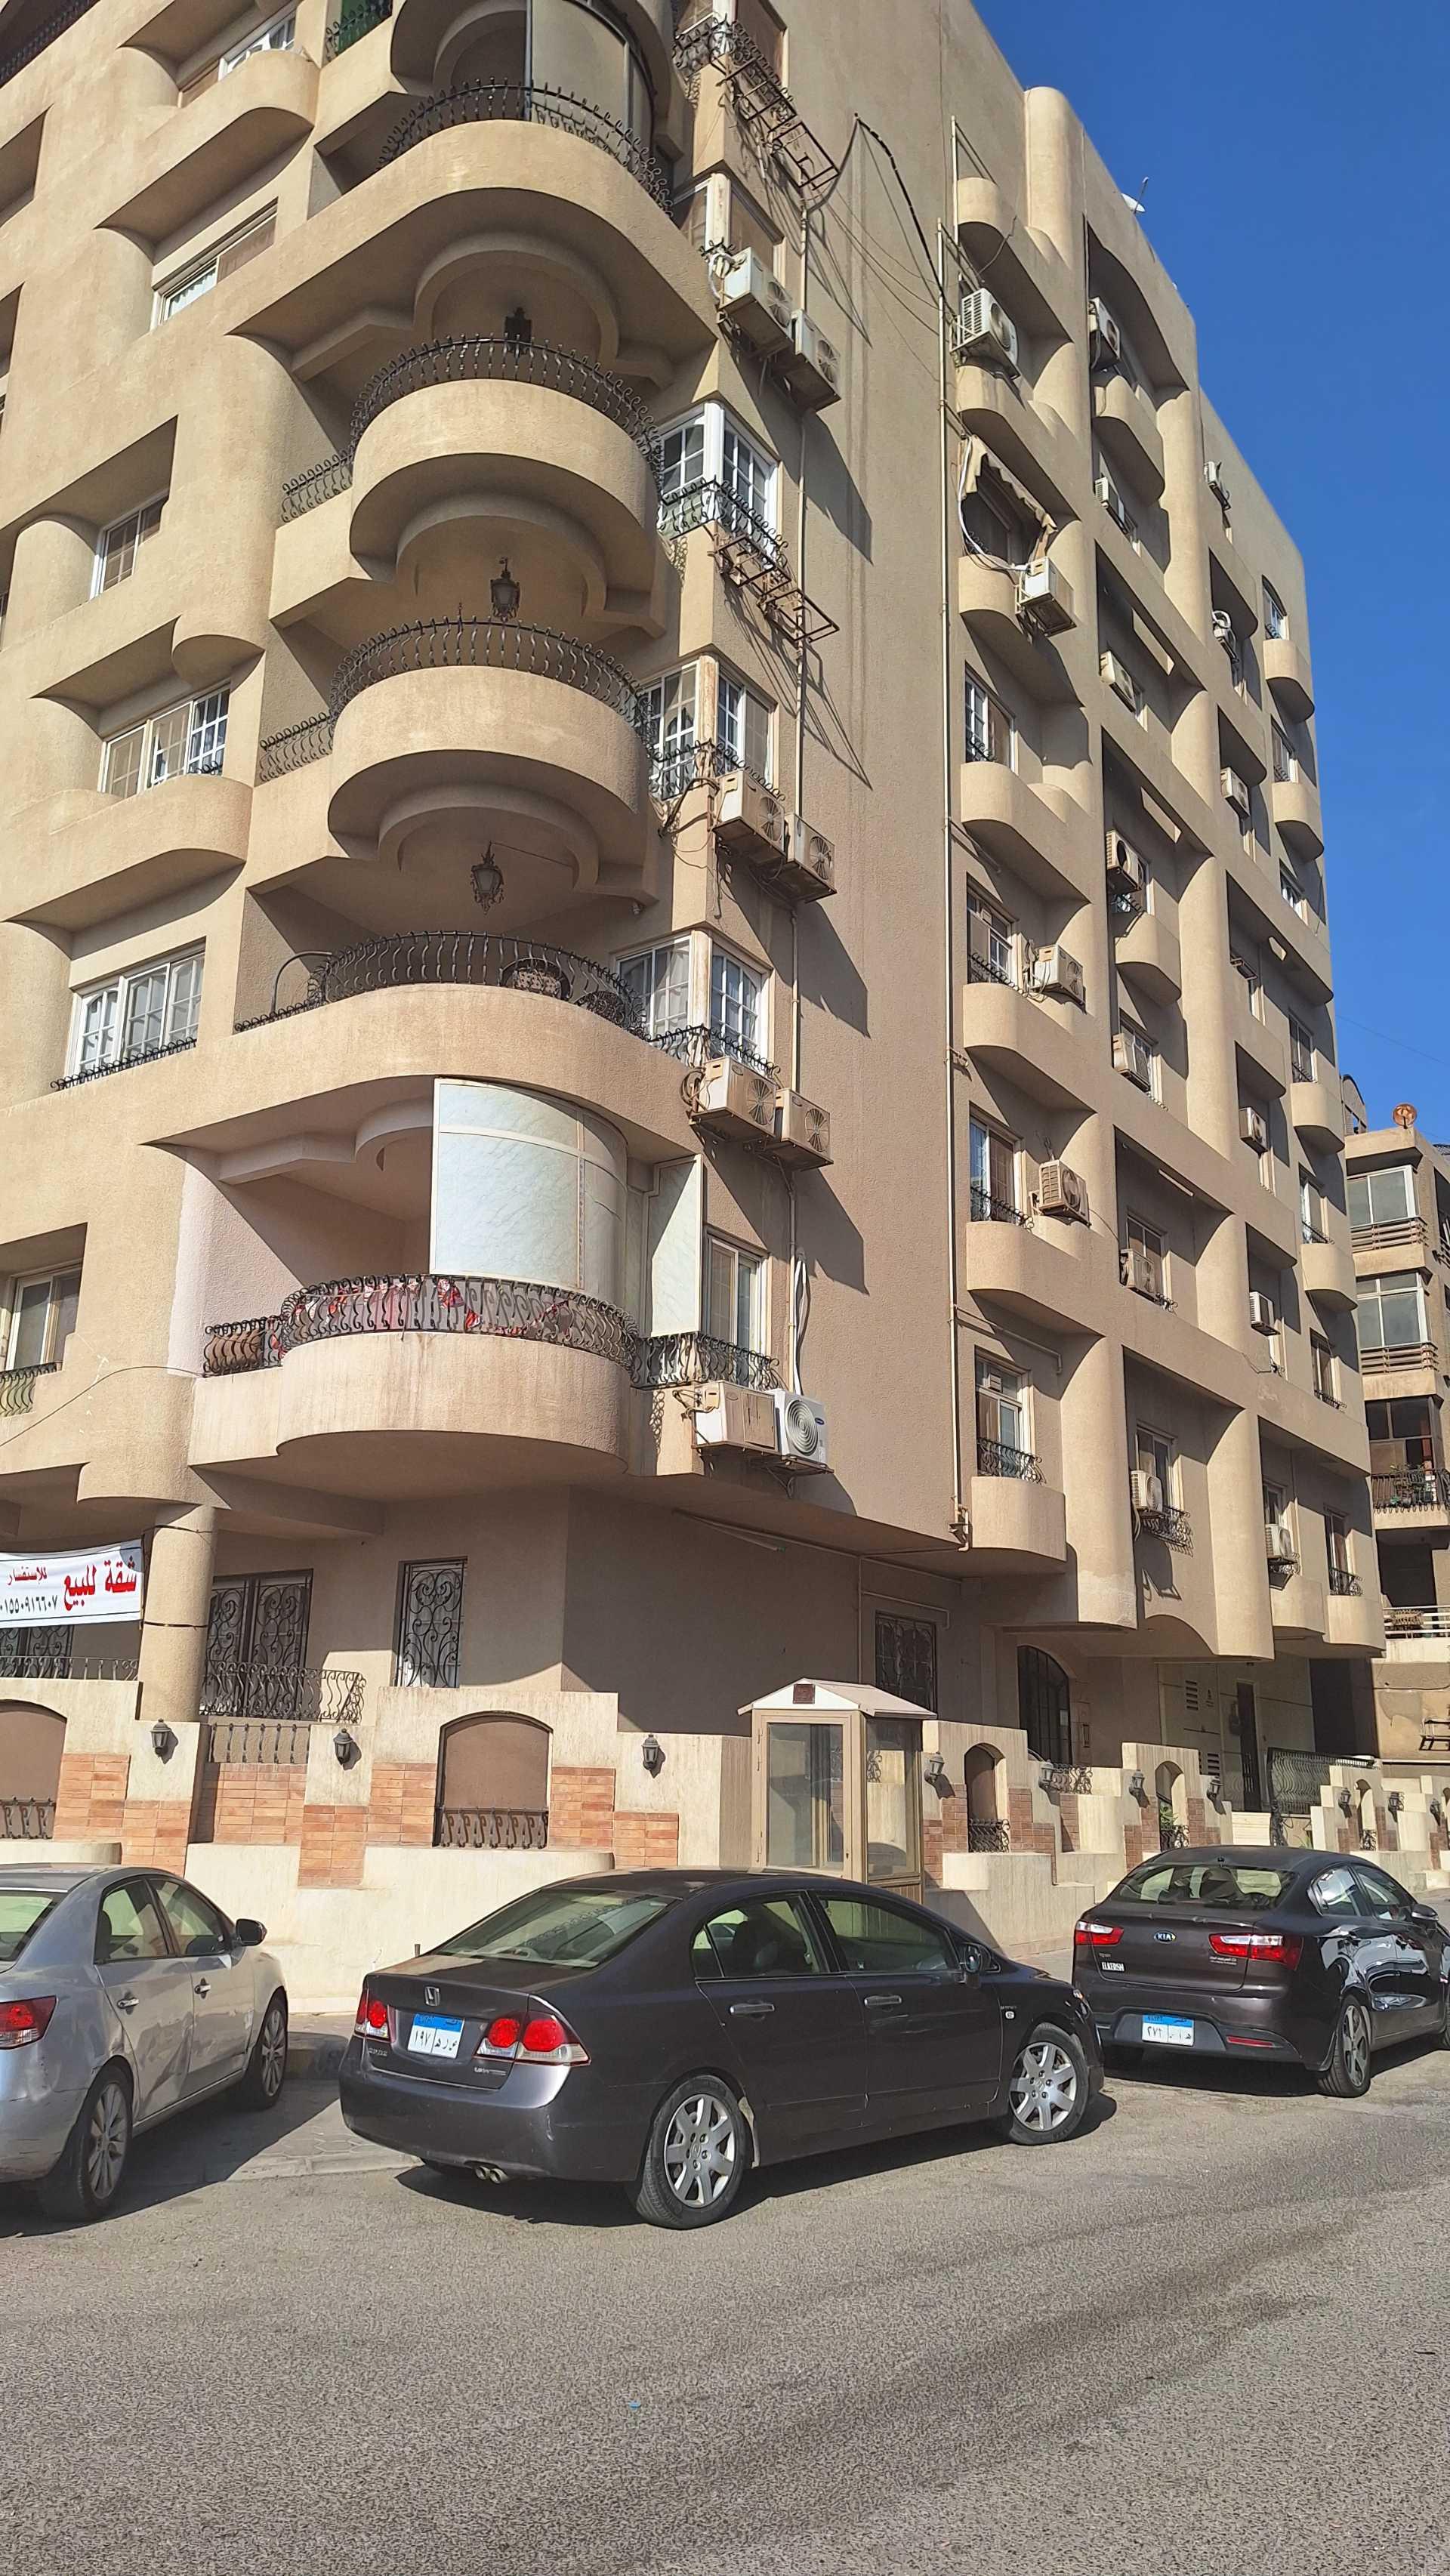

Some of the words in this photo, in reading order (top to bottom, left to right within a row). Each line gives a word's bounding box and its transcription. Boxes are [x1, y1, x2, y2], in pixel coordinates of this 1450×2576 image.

[63, 1564, 97, 1611] للبيع
[103, 1555, 137, 1593] شقة
[1156, 1933, 1172, 1941] KIA
